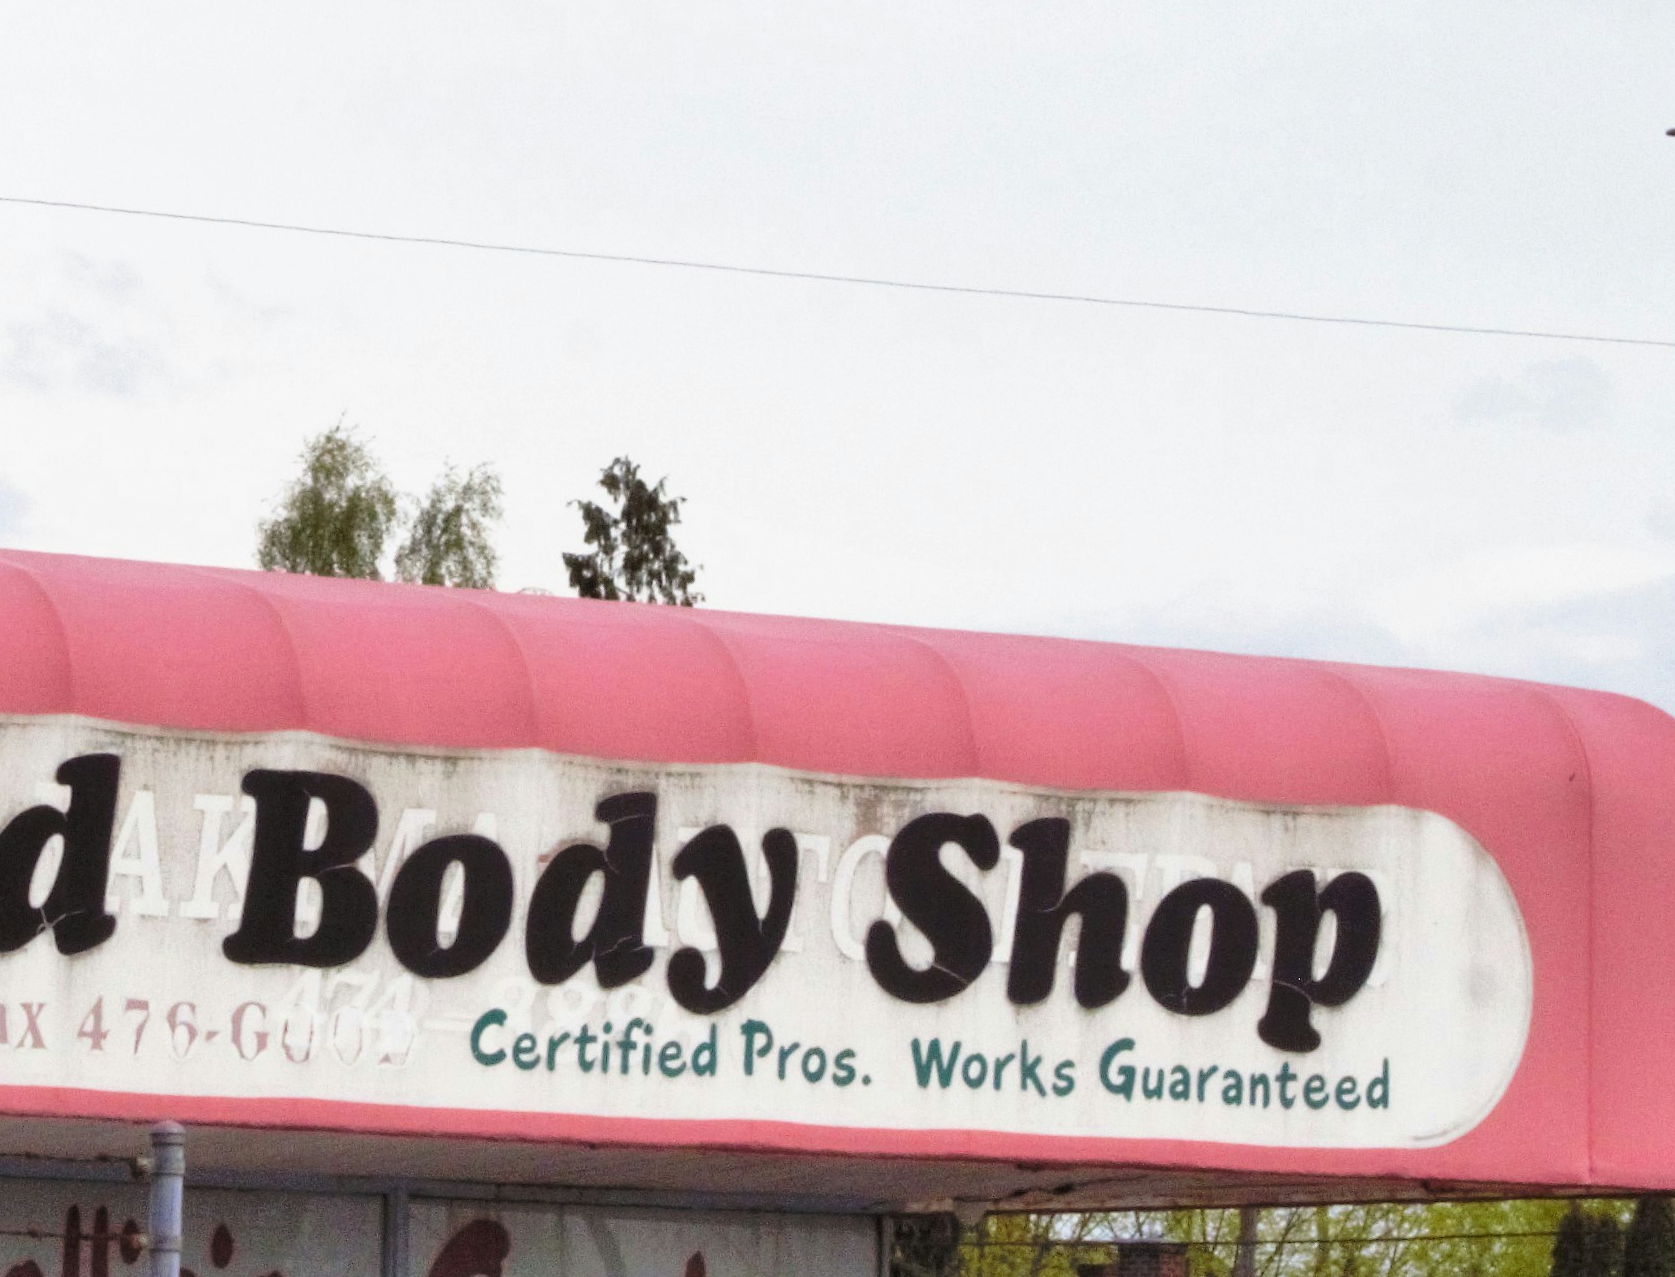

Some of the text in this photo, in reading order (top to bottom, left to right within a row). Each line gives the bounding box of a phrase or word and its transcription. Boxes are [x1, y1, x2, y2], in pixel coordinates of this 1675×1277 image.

[223, 768, 798, 1015] Body
[866, 812, 1382, 1053] Shop
[469, 1007, 1393, 1113] Certified Pros. Works Guaranteed
